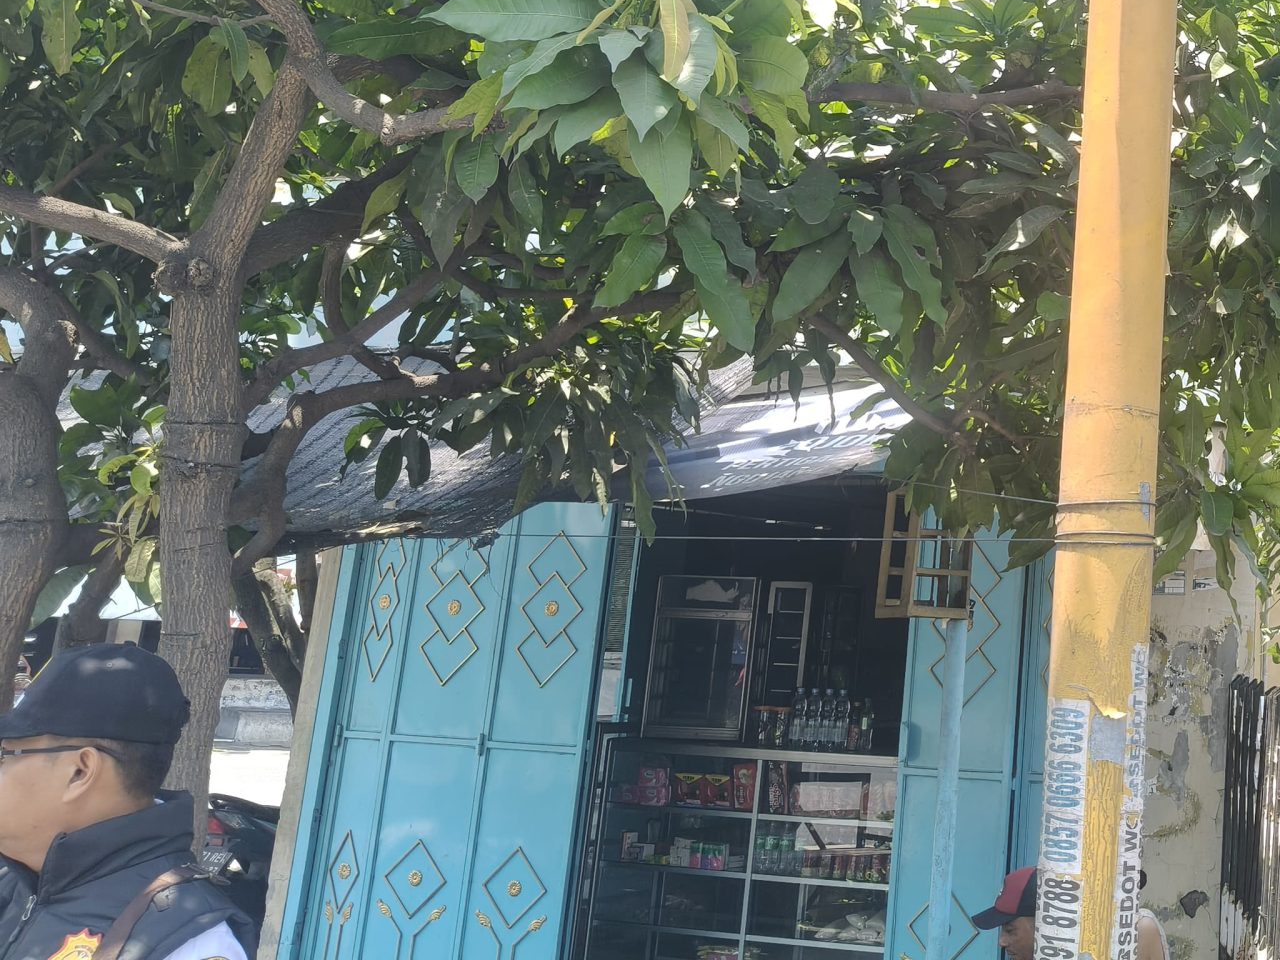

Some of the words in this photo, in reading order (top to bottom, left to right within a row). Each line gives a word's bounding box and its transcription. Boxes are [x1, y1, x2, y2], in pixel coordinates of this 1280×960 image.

[1048, 707, 1085, 754] 6309
[1129, 695, 1145, 777] SEDOT
[1046, 760, 1082, 808] 0666
[1043, 812, 1079, 863] 0857
[1041, 877, 1081, 929] 8788
[1117, 861, 1136, 946] SEDOT
[1039, 934, 1076, 960] 91
